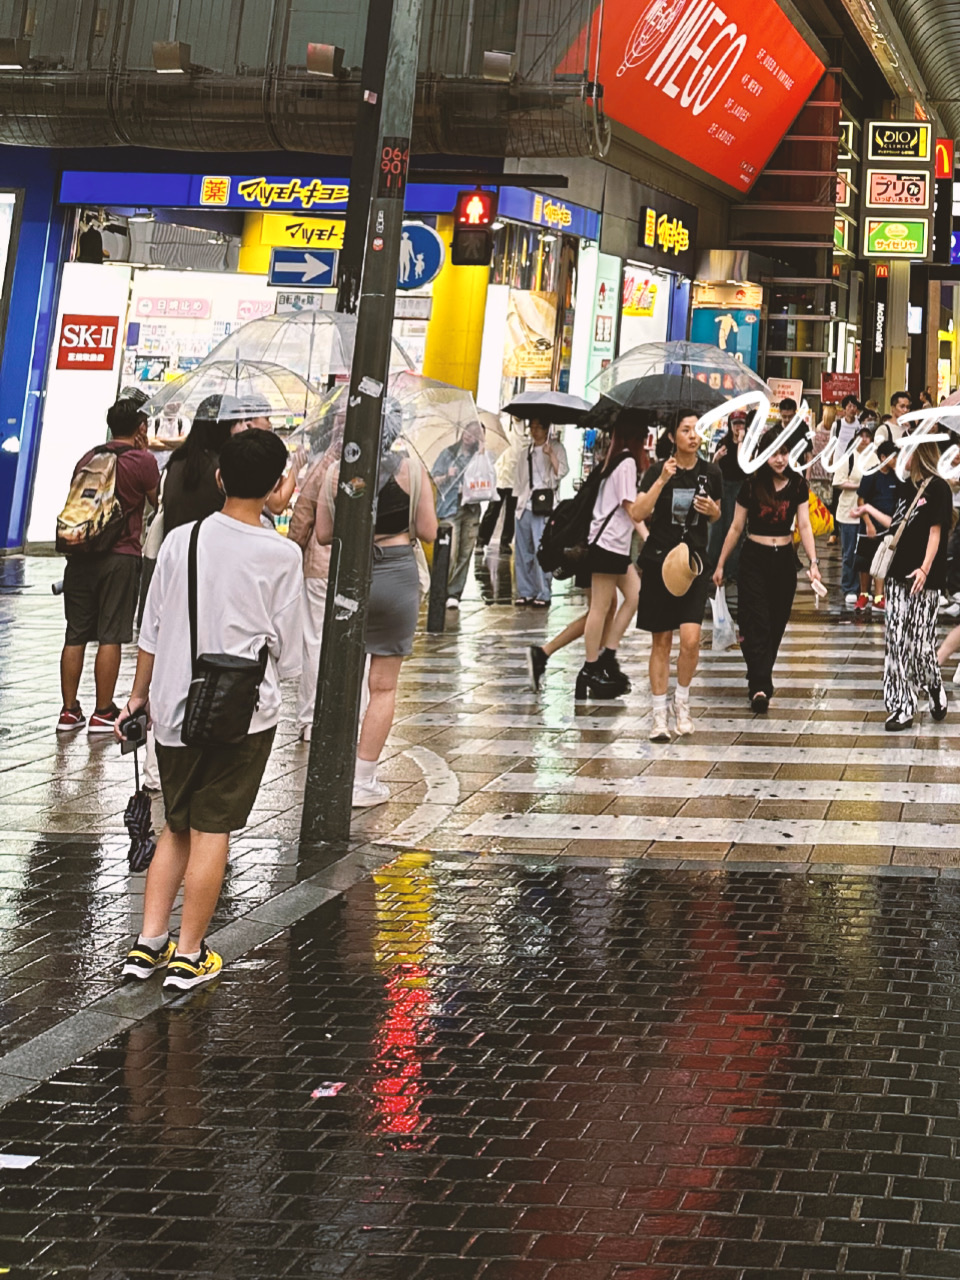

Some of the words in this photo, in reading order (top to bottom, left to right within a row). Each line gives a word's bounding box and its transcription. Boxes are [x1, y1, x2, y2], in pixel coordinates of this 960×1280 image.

[883, 131, 911, 143] DIO
[204, 179, 227, 202] 薬
[875, 180, 906, 197] プリ
[875, 302, 885, 353] McDonald's
